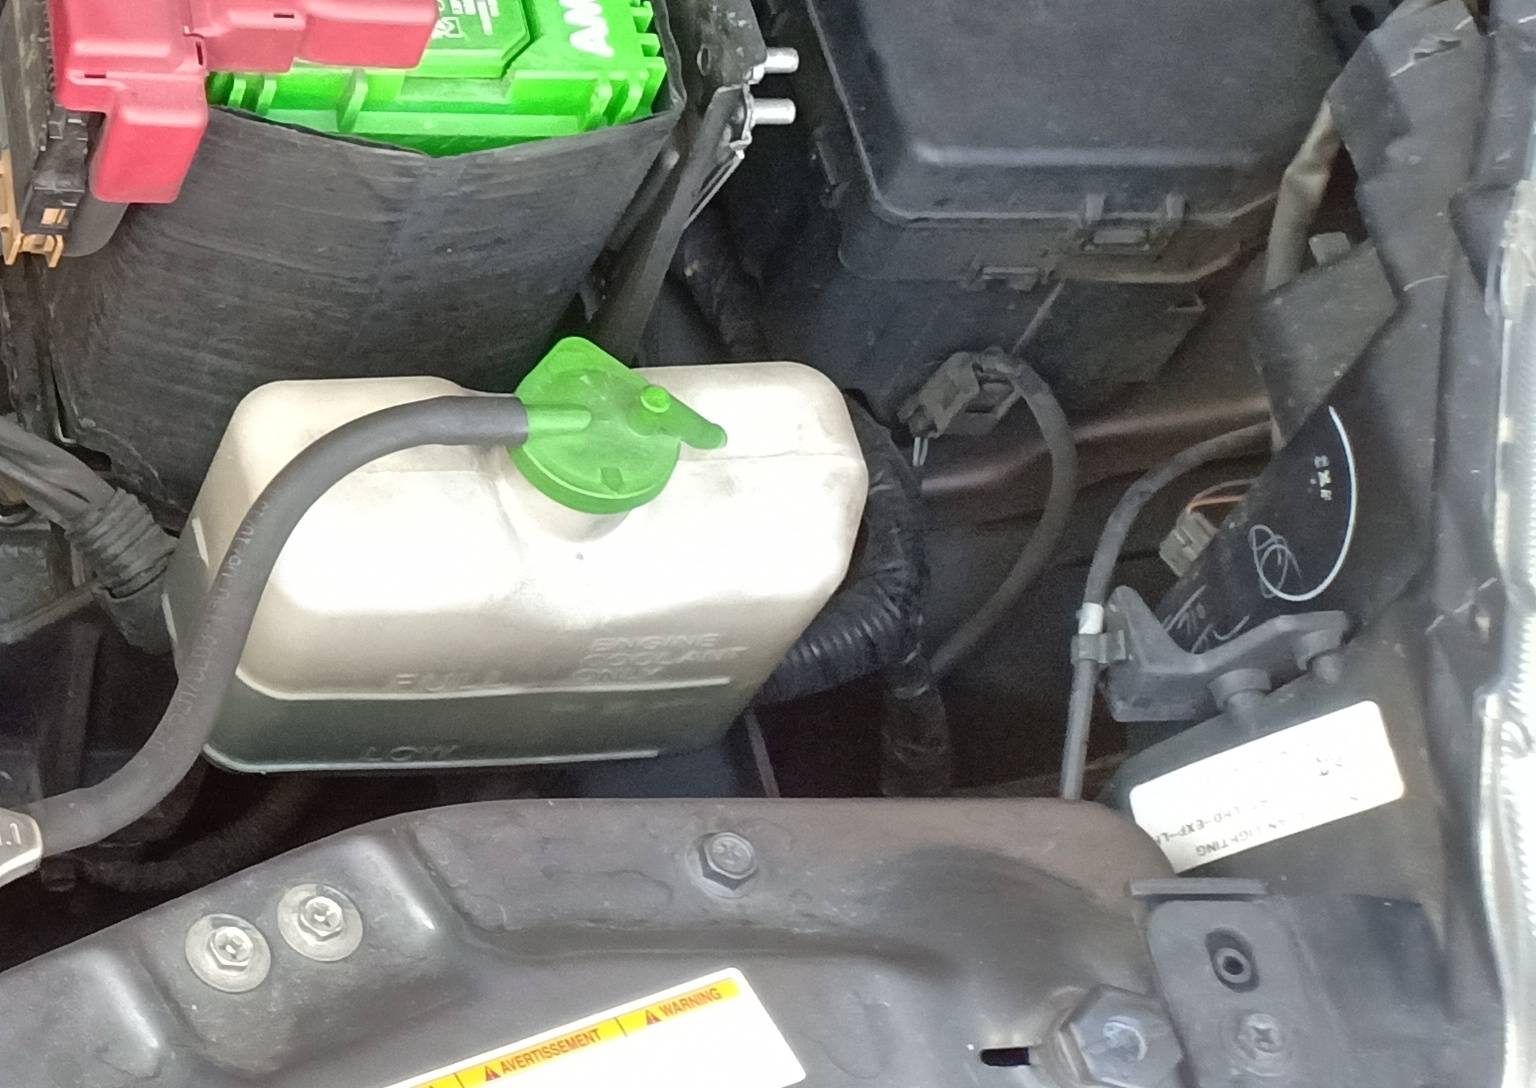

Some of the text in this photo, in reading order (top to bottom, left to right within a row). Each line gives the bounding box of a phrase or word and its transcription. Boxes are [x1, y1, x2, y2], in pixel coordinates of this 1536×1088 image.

[360, 744, 461, 762] LOW
[500, 986, 722, 1075] AVERTISSEMENT WARNING
